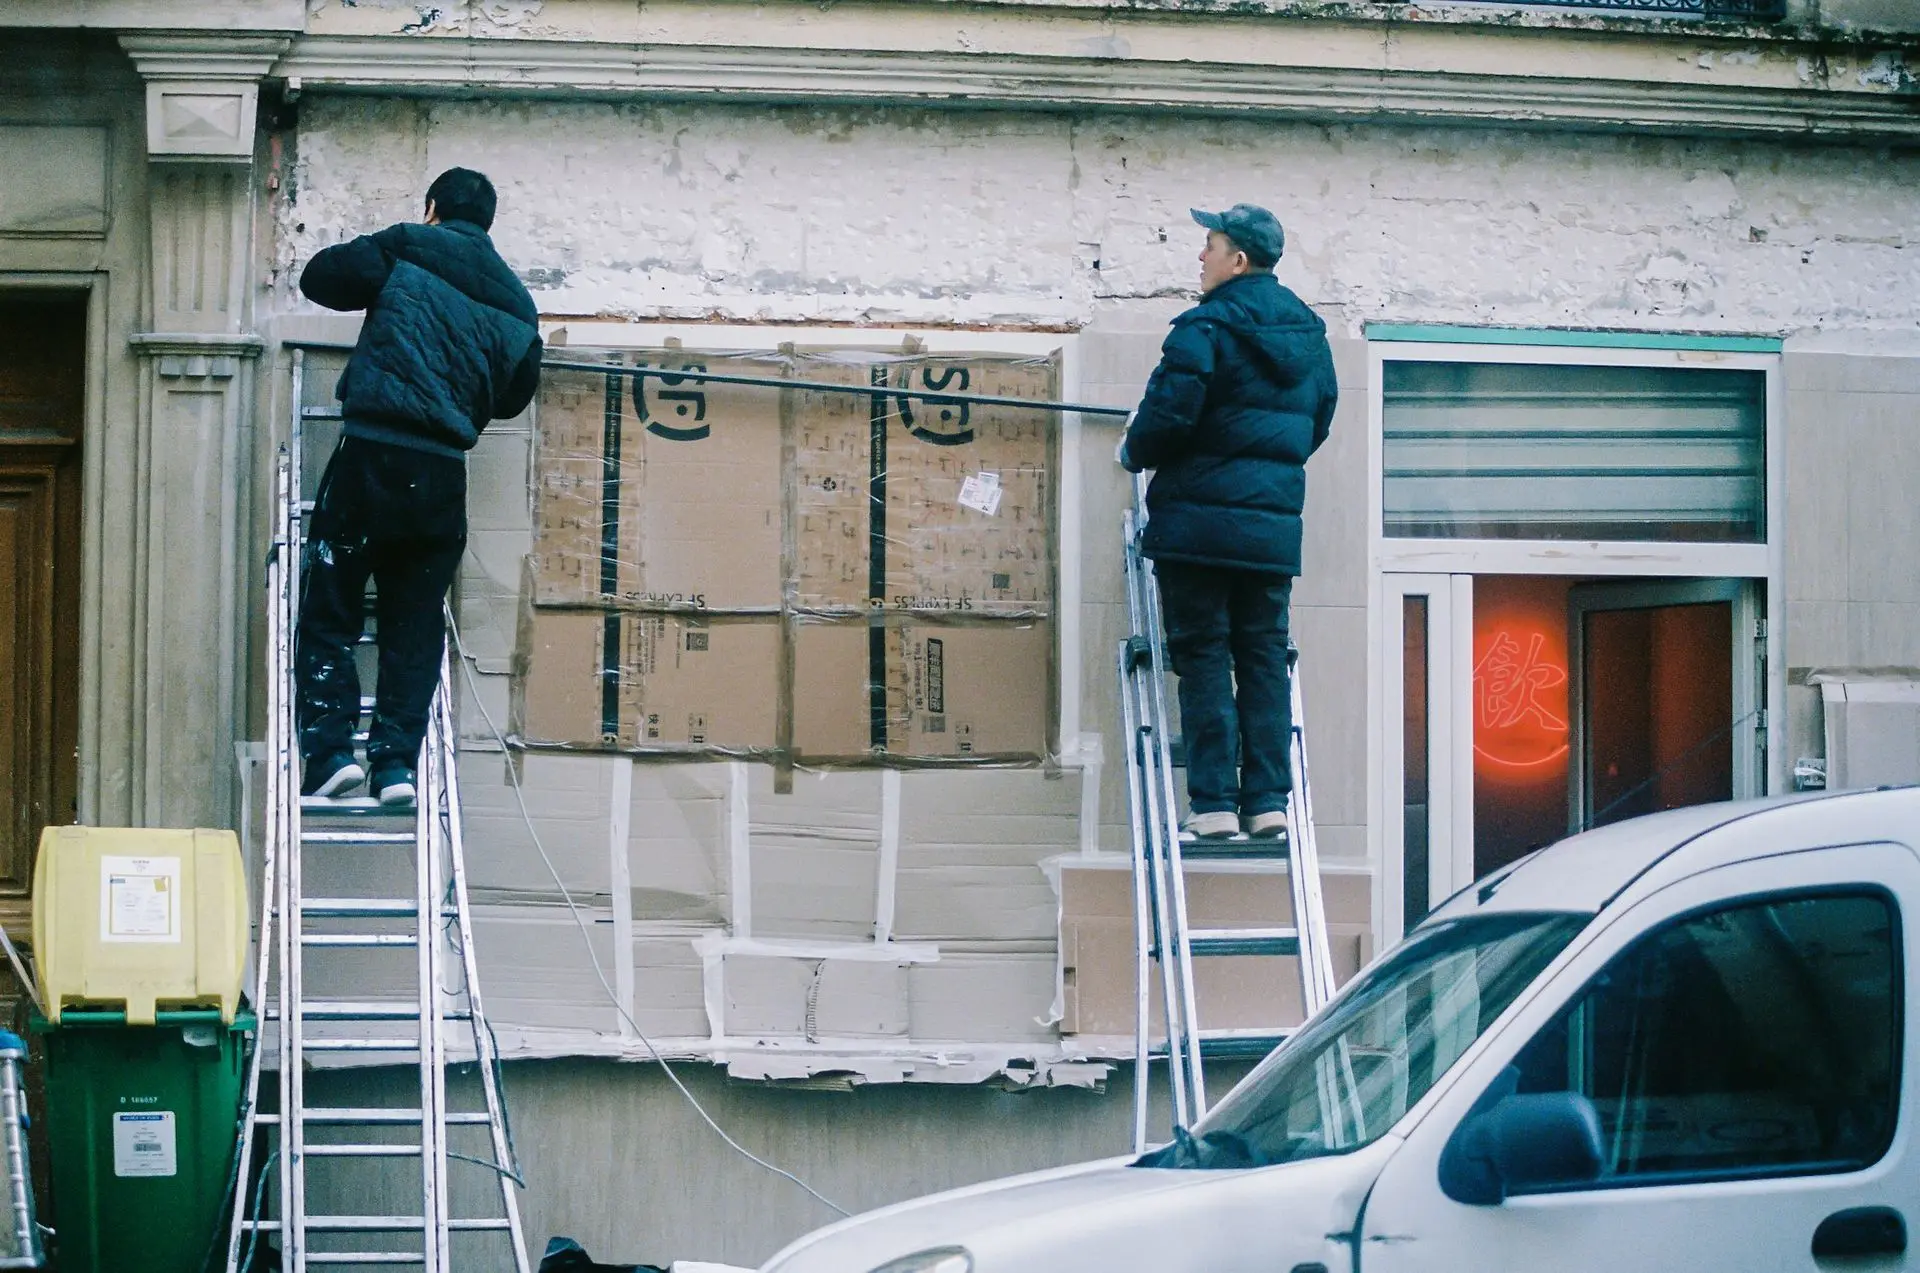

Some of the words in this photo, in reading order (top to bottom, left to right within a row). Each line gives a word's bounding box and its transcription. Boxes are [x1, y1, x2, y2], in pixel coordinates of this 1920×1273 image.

[922, 366, 970, 427] SF
[955, 597, 973, 610] SF
[1472, 632, 1568, 730] 飲
